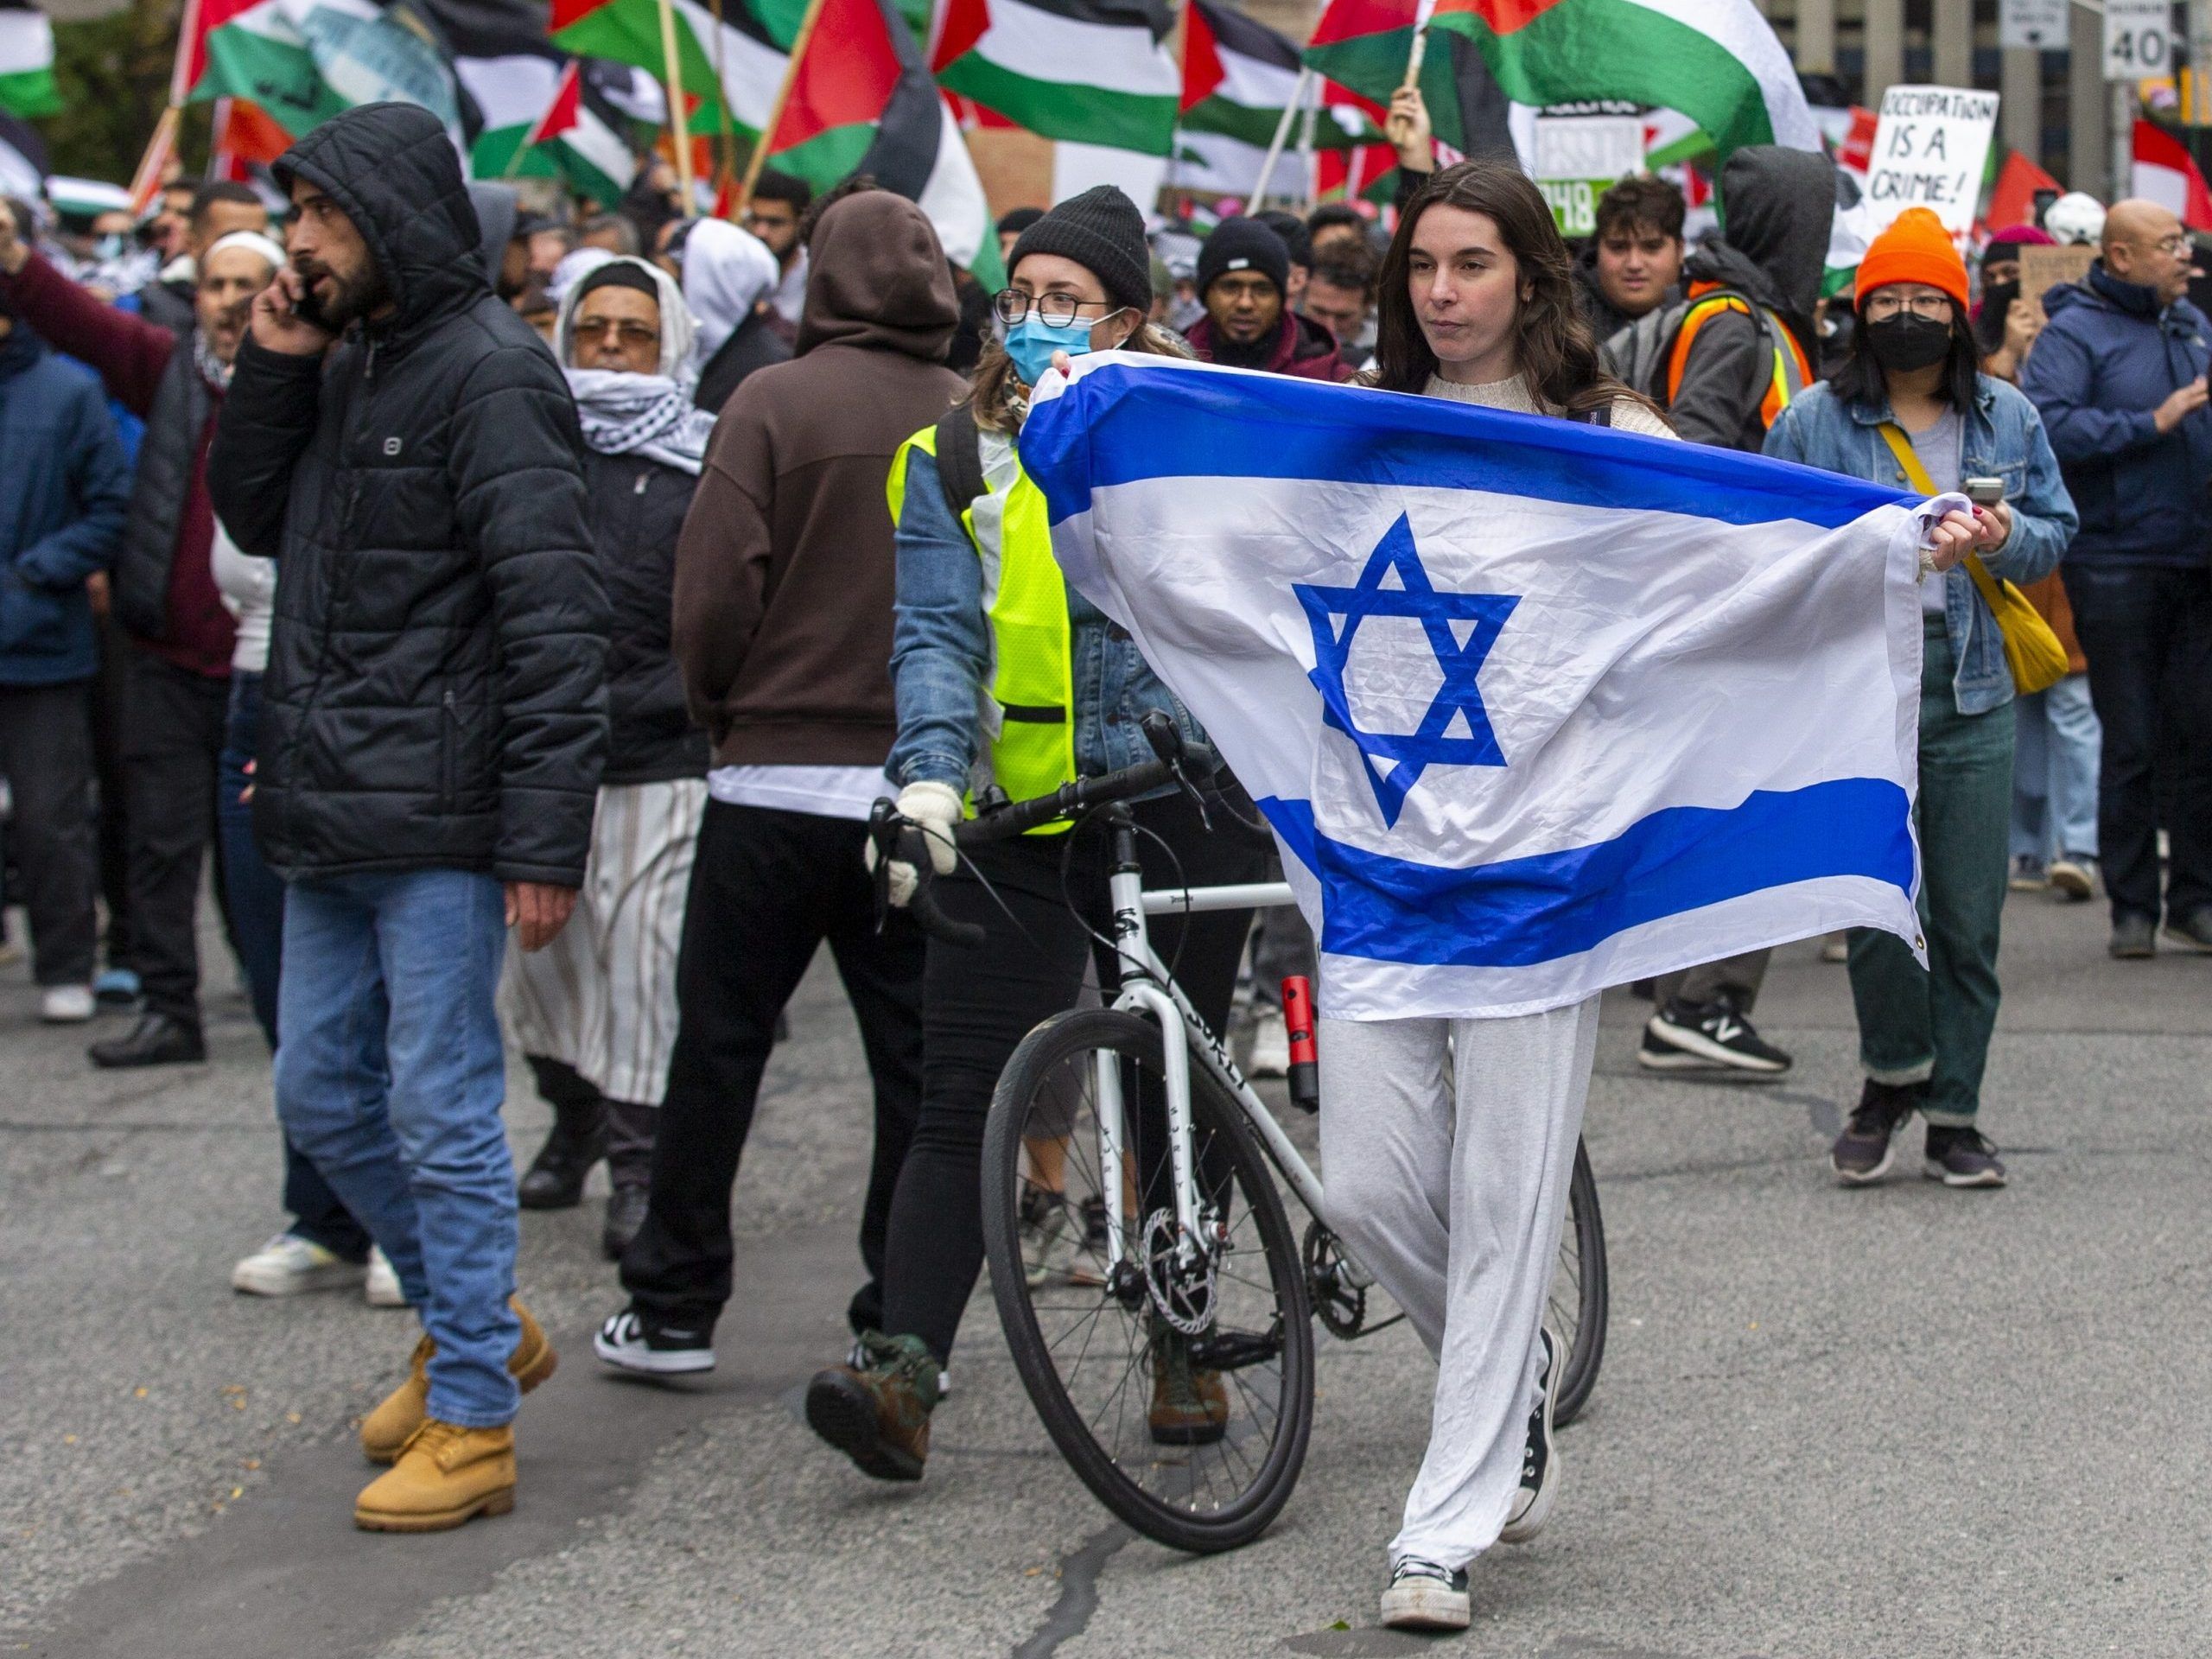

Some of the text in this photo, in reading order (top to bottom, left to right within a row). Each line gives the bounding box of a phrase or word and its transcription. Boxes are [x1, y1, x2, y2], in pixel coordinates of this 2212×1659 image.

[2113, 29, 2164, 67] 40
[1883, 92, 1992, 120] OCCUPATION
[1888, 124, 1946, 162] IS A
[1871, 168, 1967, 204] CRIME!
[1186, 1013, 1246, 1090] SURLY
[1170, 1106, 1185, 1189] SURLY
